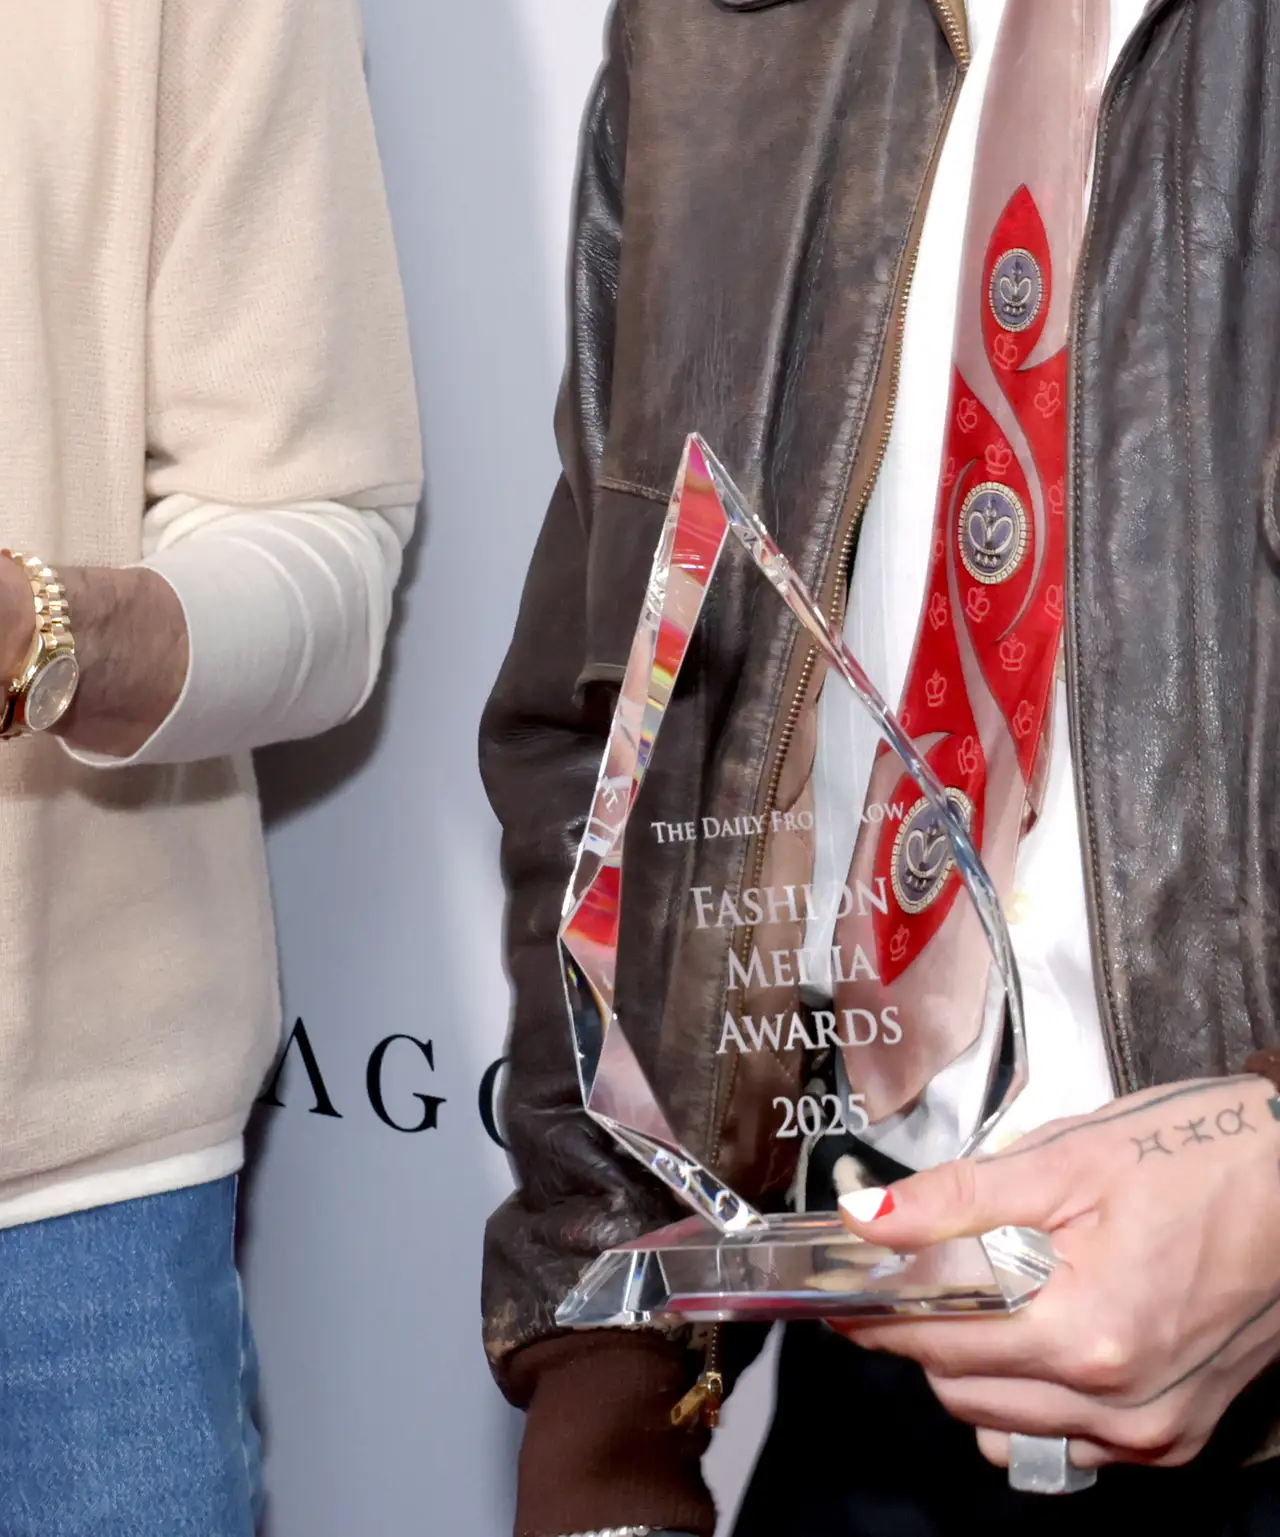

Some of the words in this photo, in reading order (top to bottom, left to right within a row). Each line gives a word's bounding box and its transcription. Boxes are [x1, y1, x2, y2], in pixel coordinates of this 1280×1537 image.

[651, 820, 698, 844] THE
[701, 814, 766, 841] DAILY
[770, 810, 839, 834] FRO
[715, 1005, 903, 1055] AWARDS
[772, 1092, 870, 1139] 2025
